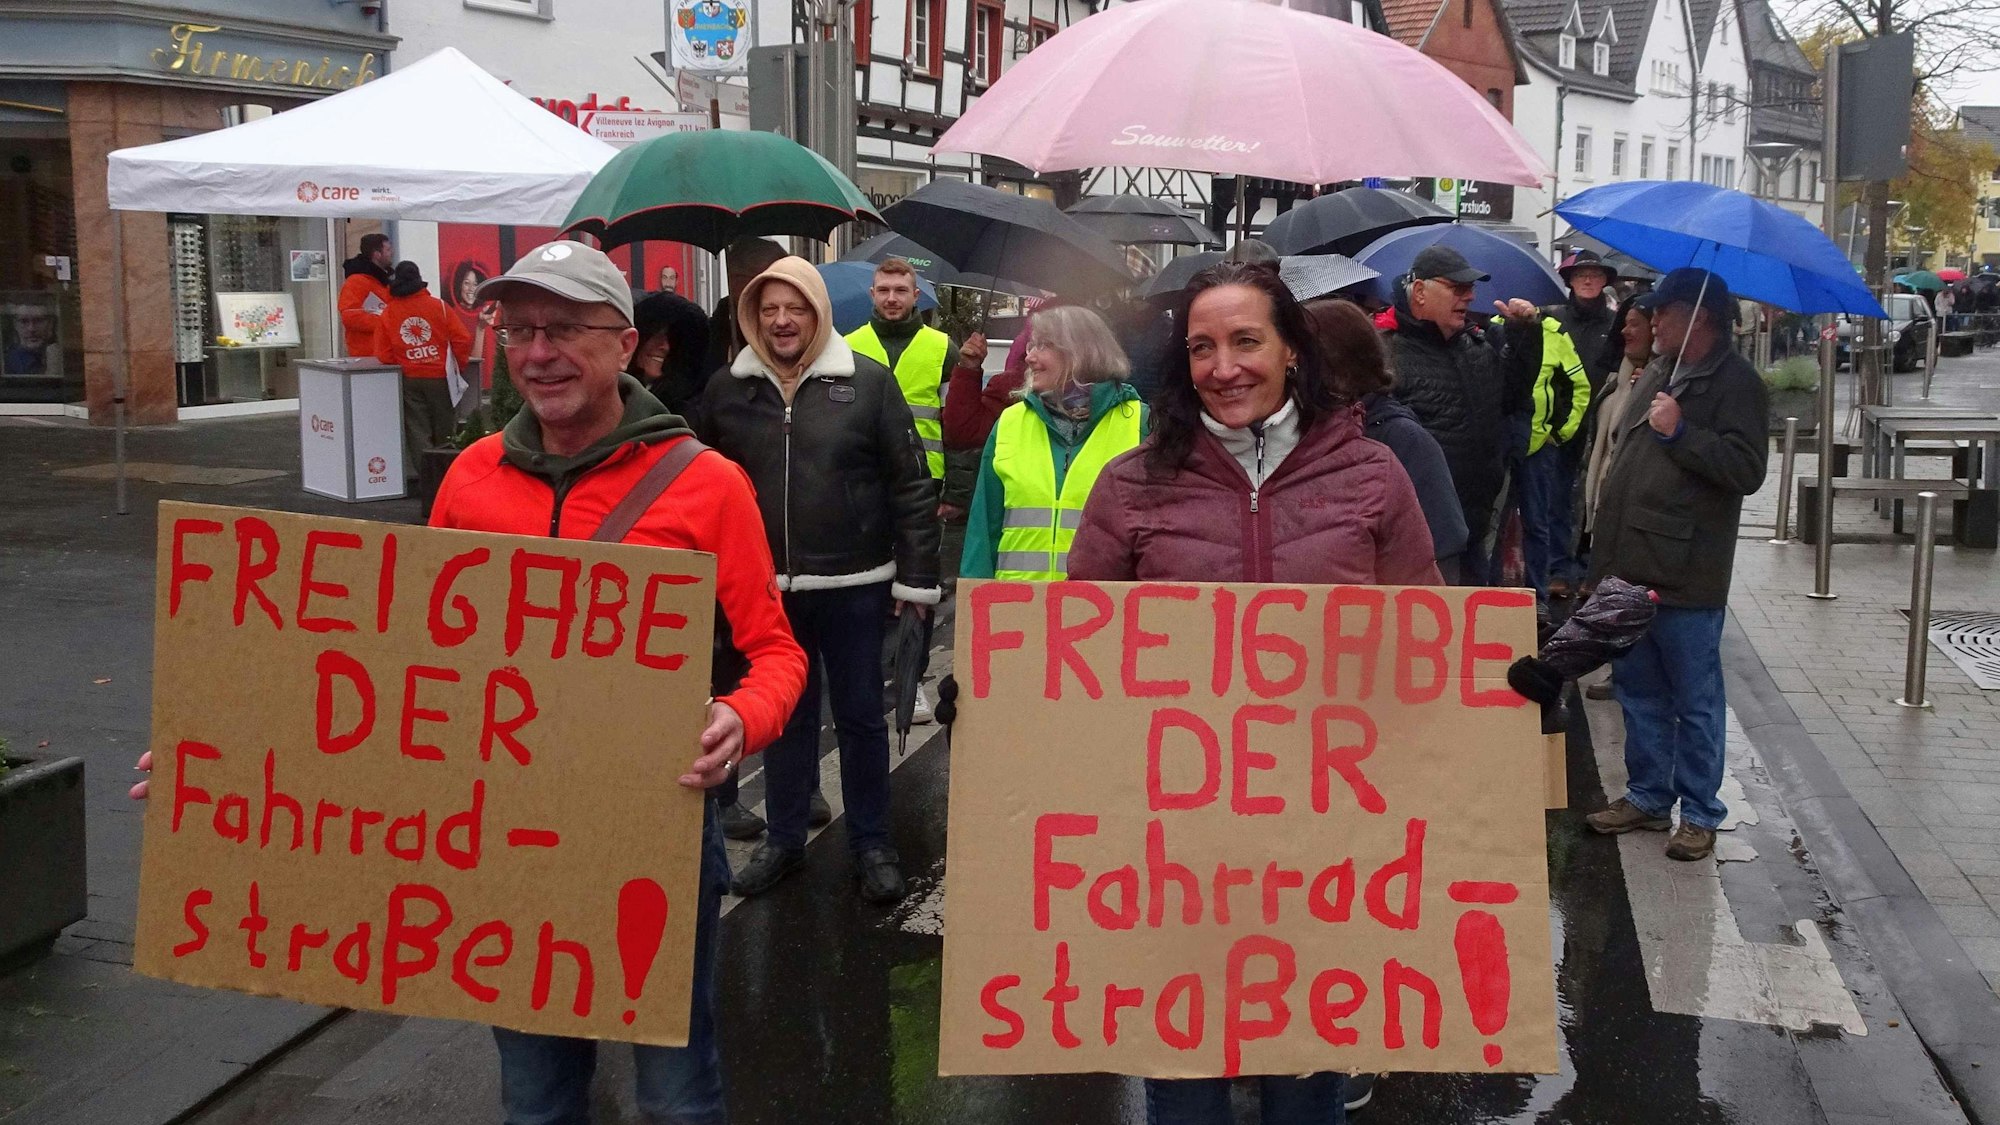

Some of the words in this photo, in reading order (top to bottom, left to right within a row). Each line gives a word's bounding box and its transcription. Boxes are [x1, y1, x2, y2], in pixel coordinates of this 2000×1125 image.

[151, 24, 376, 87] Firmenich
[595, 117, 633, 126] Villeneuve
[634, 118, 646, 127] lez
[648, 119, 675, 129] Avignon
[595, 130, 635, 138] Frankreich
[1111, 124, 1261, 153] Sauwetter!
[321, 186, 360, 200] care
[907, 257, 932, 267] PMC
[406, 345, 439, 360] care
[320, 419, 334, 433] care
[368, 475, 387, 484] care
[169, 501, 699, 672] FREIGABE
[970, 584, 1537, 710] FREIGABE
[312, 648, 541, 767] DER
[1146, 702, 1388, 816] DER
[172, 876, 670, 1026] straßen!
[979, 908, 1512, 1078] straßen!
